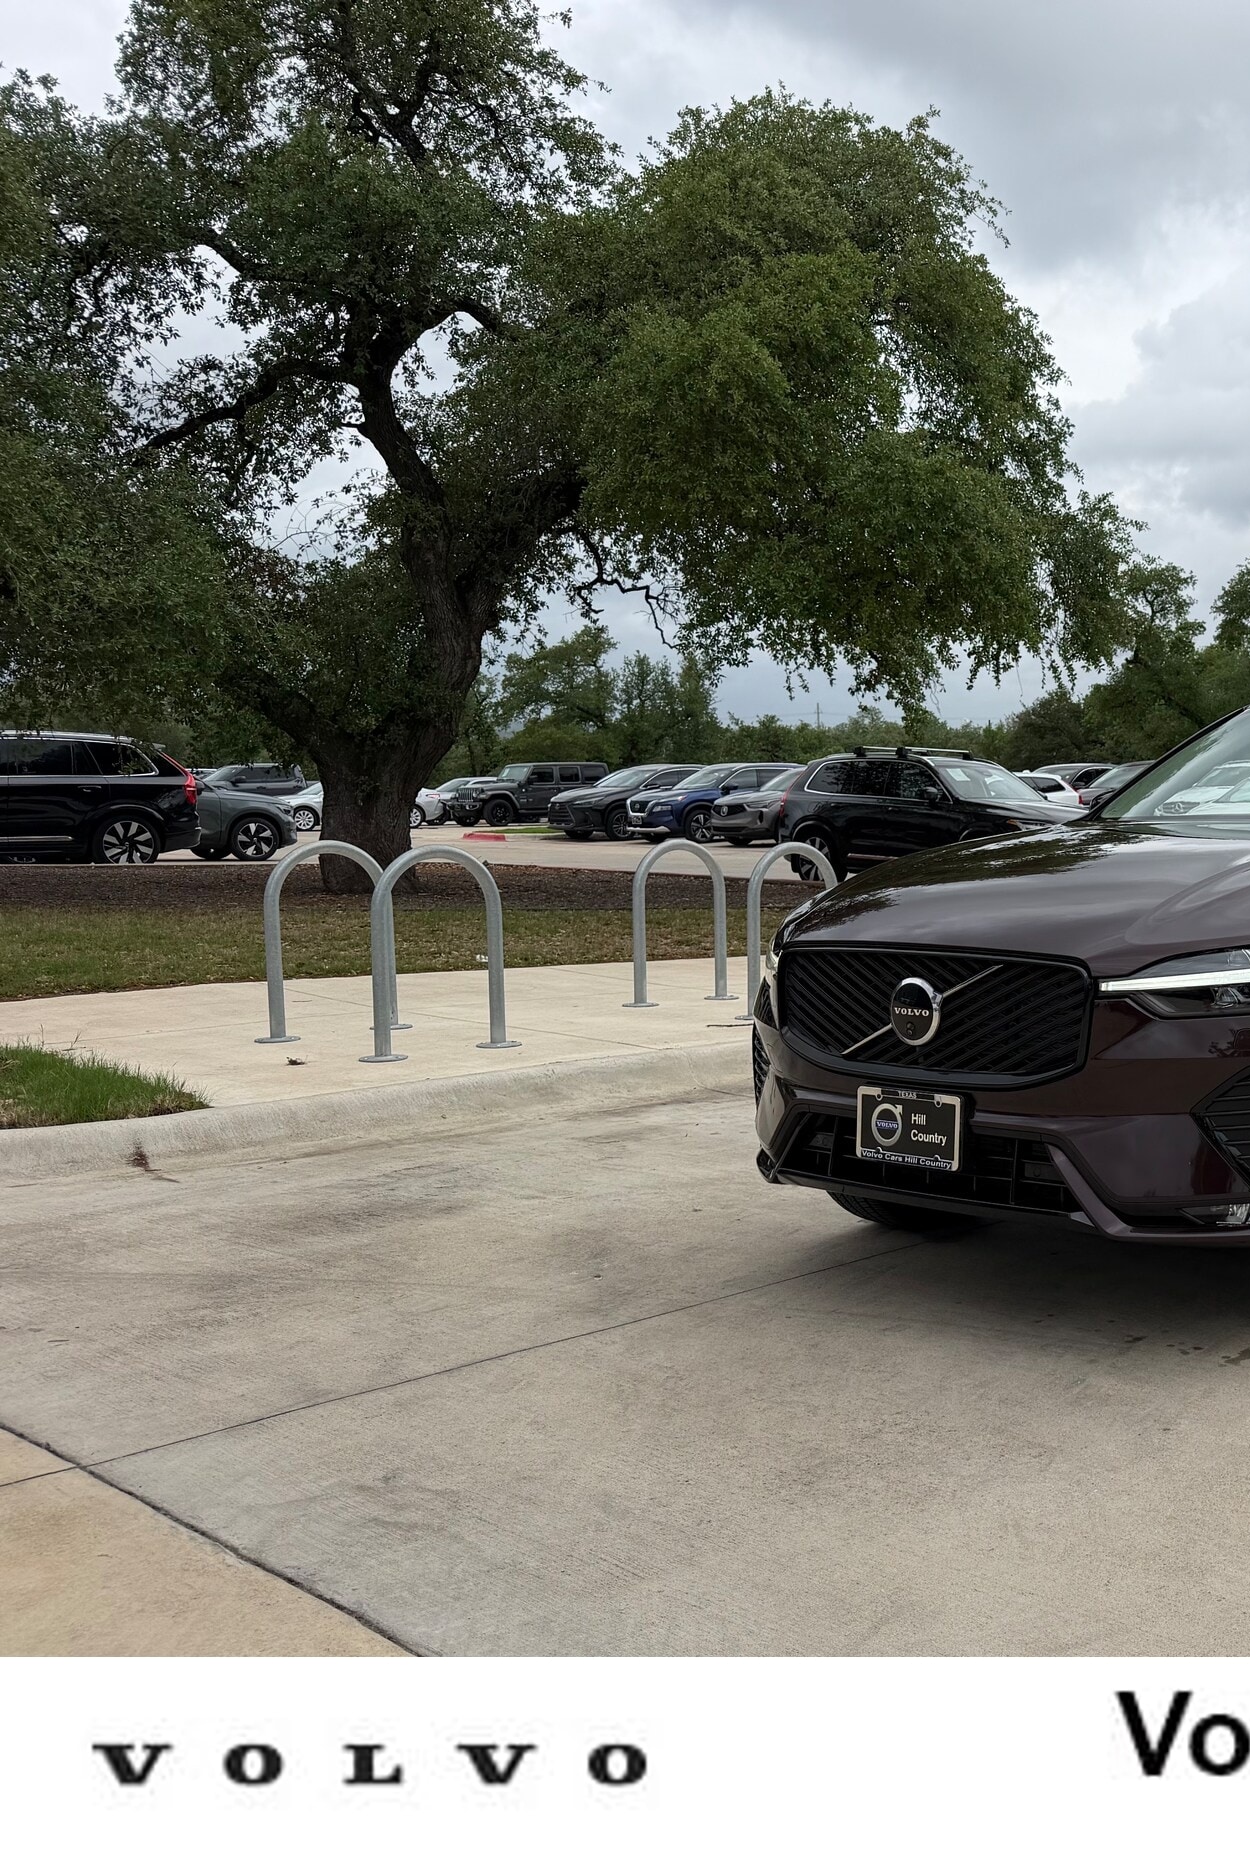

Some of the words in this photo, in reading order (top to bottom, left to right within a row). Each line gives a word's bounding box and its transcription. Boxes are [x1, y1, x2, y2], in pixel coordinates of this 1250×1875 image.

[894, 1007, 930, 1017] VOLVO
[898, 1090, 917, 1099] TEXAS
[911, 1113, 926, 1125] Hill
[876, 1121, 898, 1129] VOLVO
[910, 1129, 947, 1146] Country
[862, 1150, 883, 1159] Volvo
[884, 1153, 903, 1162] Cars
[904, 1155, 918, 1164] Hill
[919, 1158, 952, 1169] Country
